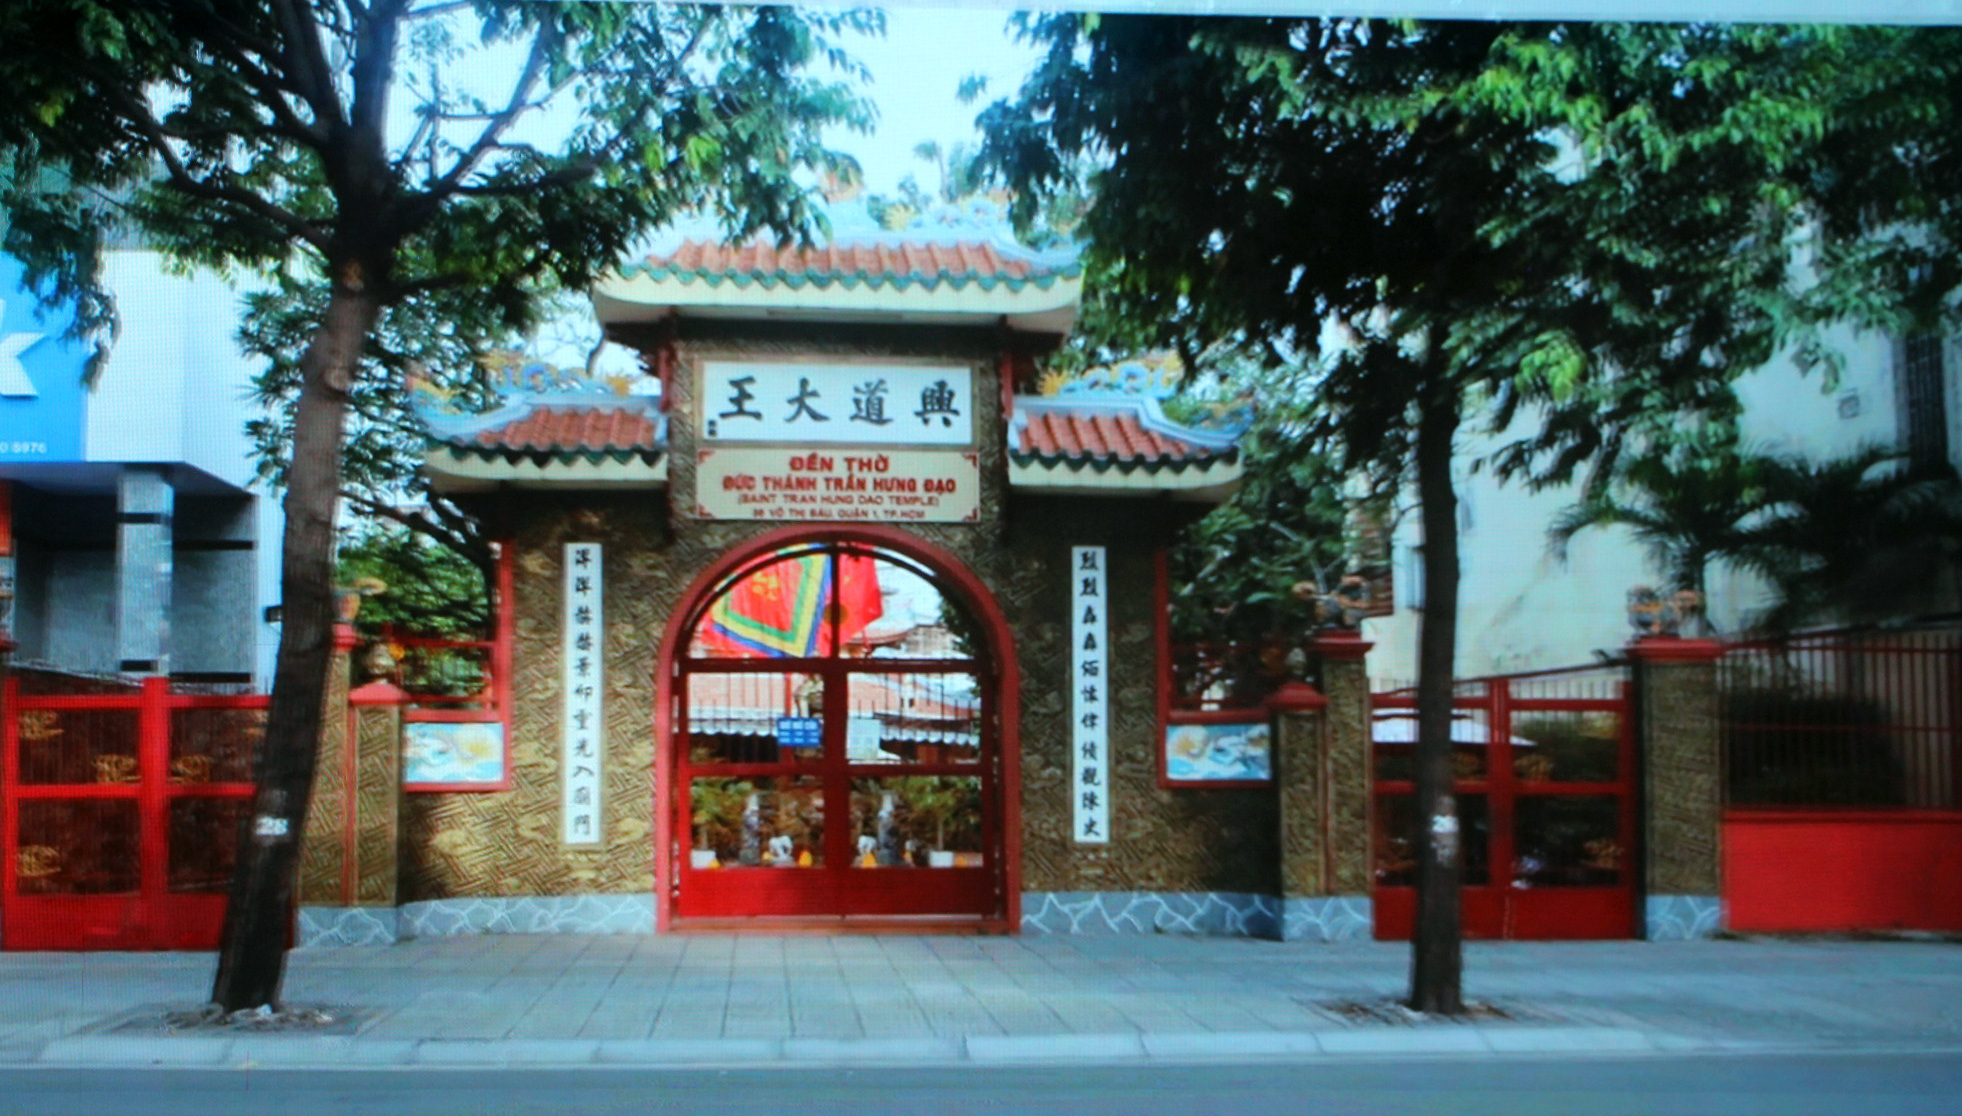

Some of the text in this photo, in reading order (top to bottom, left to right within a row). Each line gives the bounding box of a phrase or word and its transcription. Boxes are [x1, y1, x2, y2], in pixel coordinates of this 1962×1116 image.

[843, 454, 889, 473] THỜ
[762, 474, 817, 491] THÁNH
[923, 478, 956, 496] ĐẠO
[783, 494, 817, 504] TRAN
[821, 495, 854, 505] HUNG
[858, 495, 884, 505] DAO
